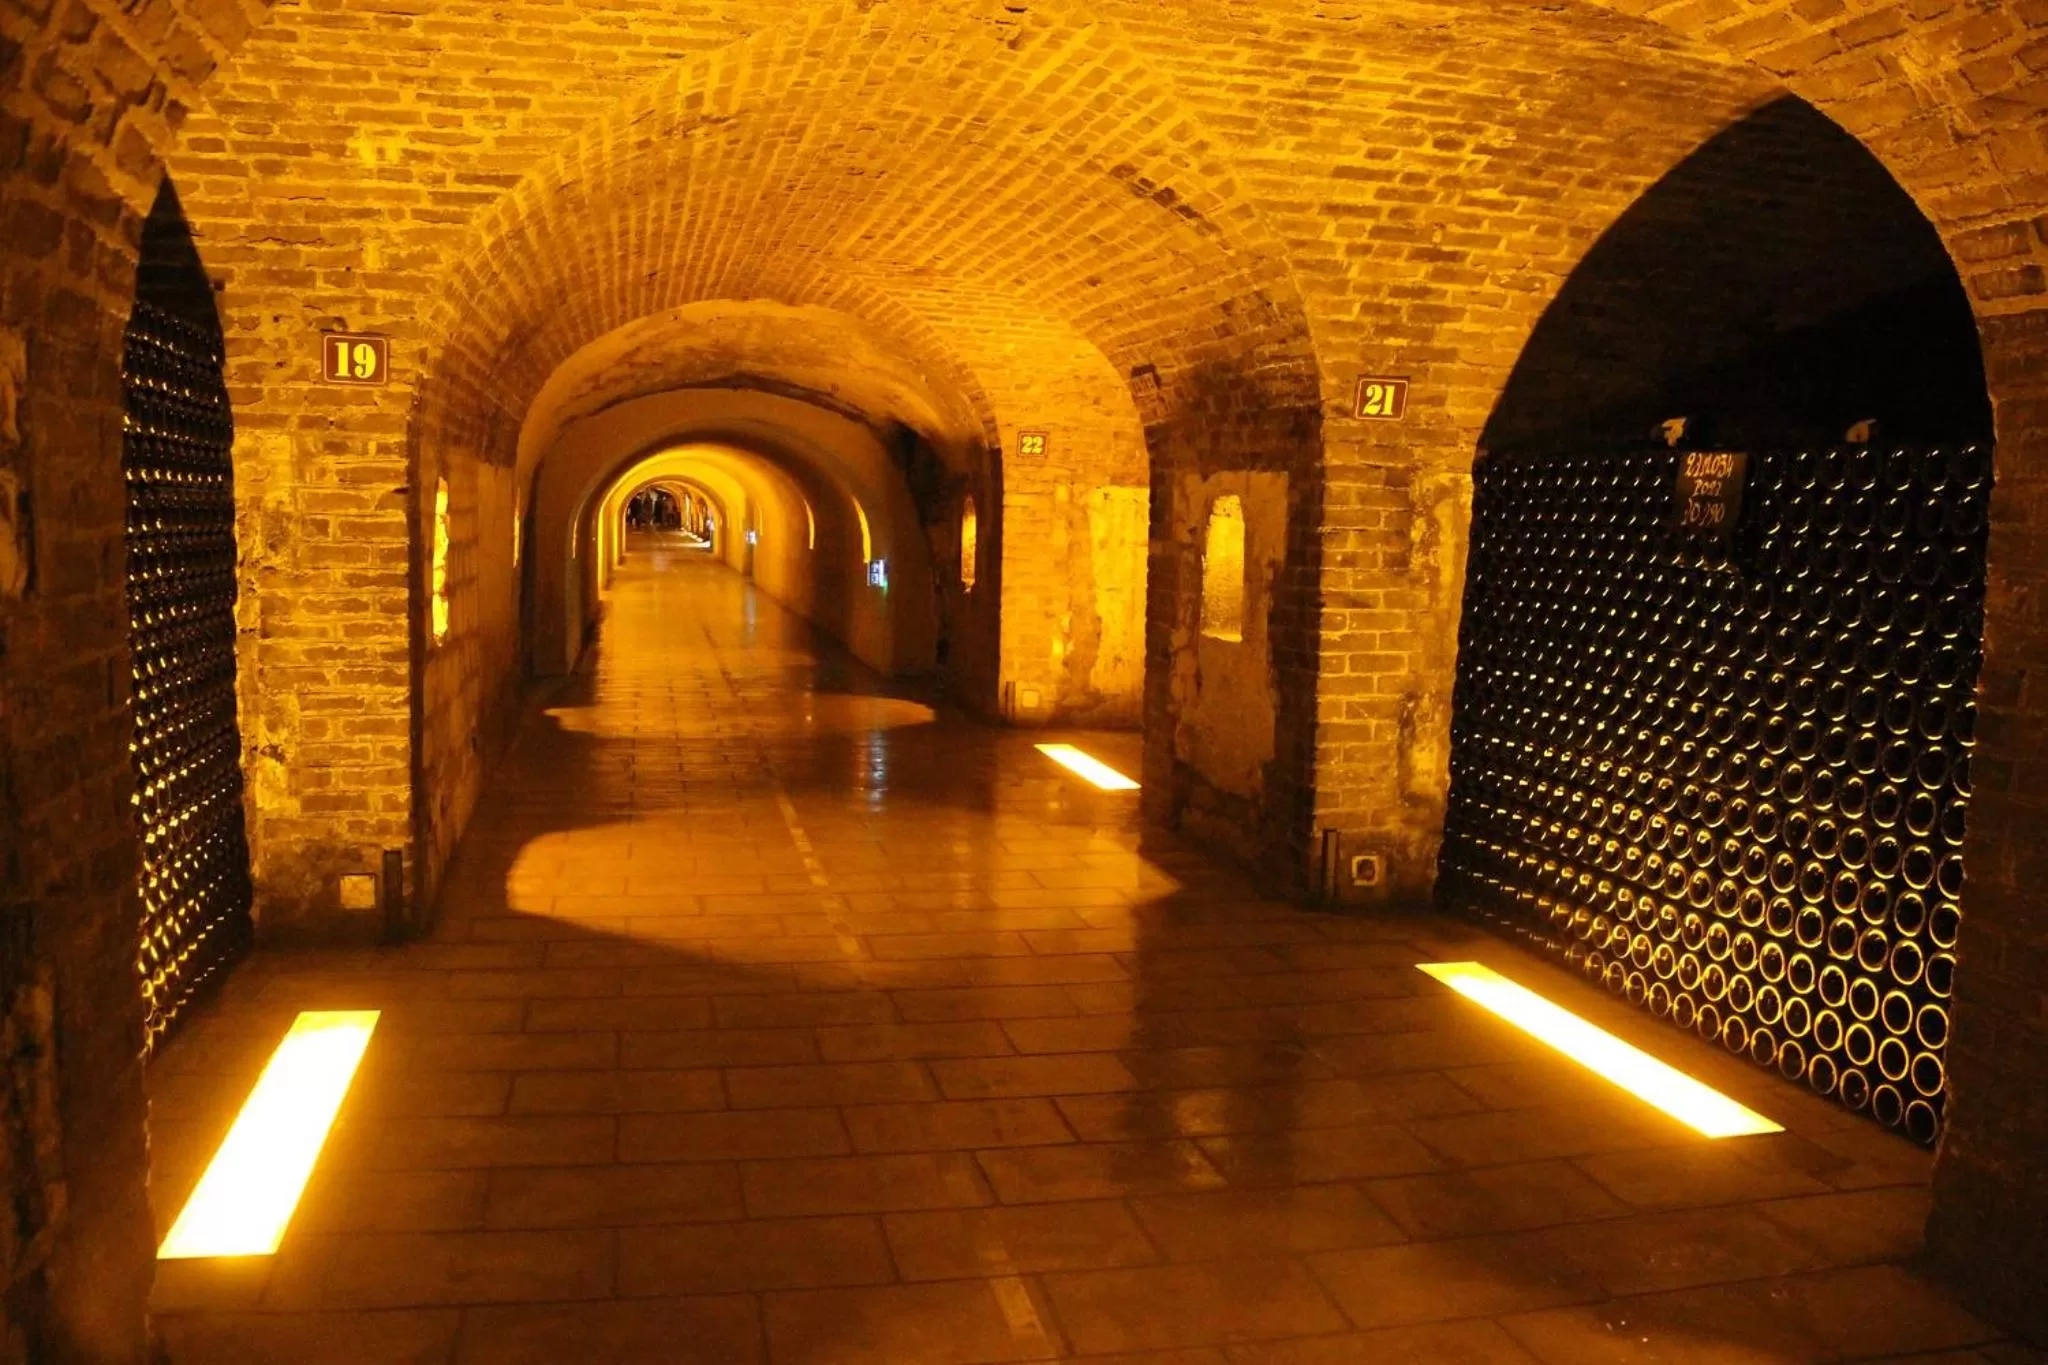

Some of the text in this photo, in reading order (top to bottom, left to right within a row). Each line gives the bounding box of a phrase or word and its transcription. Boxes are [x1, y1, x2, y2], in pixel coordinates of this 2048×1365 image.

[335, 342, 376, 379] 19
[1362, 384, 1395, 416] 21
[1021, 436, 1043, 454] 22
